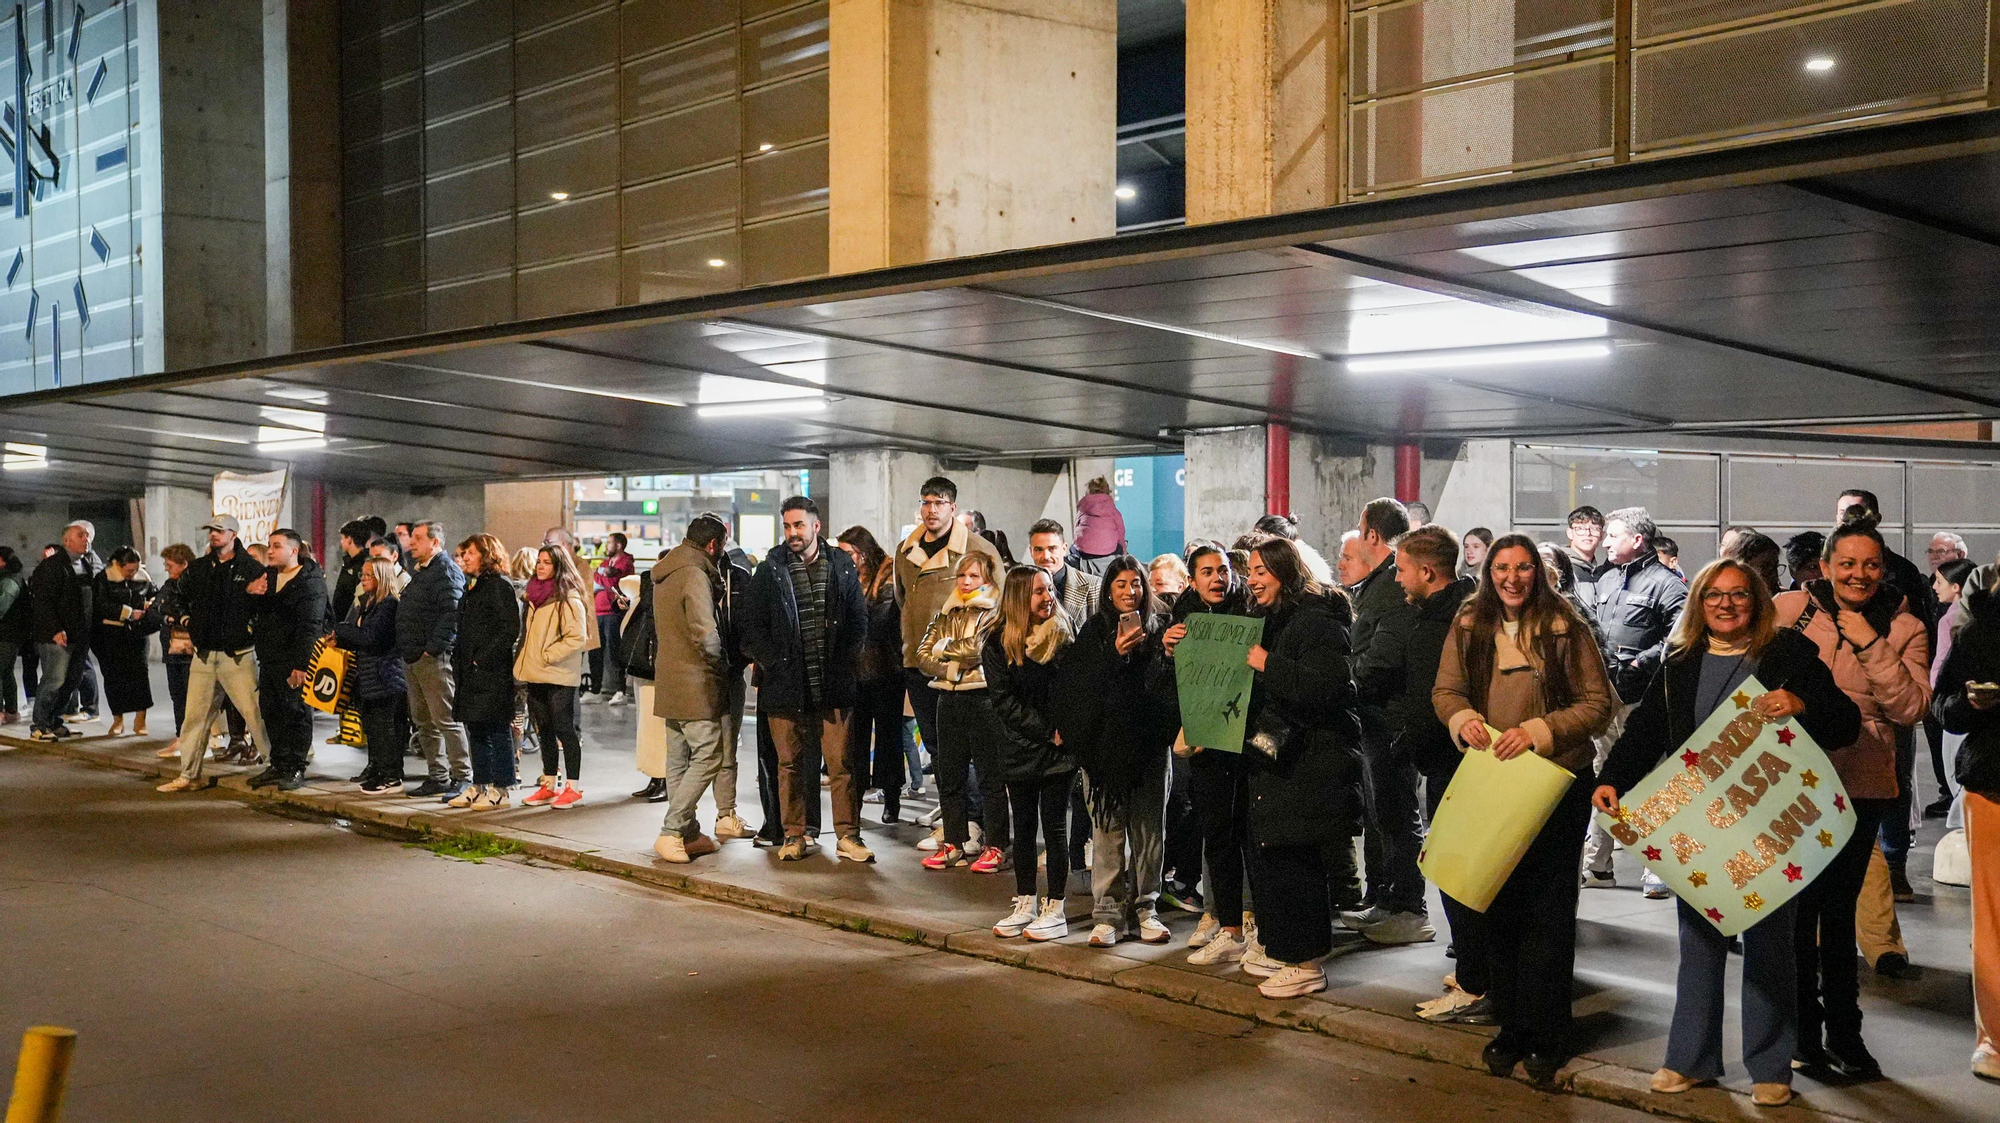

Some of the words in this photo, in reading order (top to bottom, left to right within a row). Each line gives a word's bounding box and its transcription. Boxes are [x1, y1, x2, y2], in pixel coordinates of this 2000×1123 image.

[314, 674, 336, 696] JD
[1669, 831, 1706, 865] A
[1705, 751, 1792, 829] CASA
[1723, 792, 1822, 890] MANU
